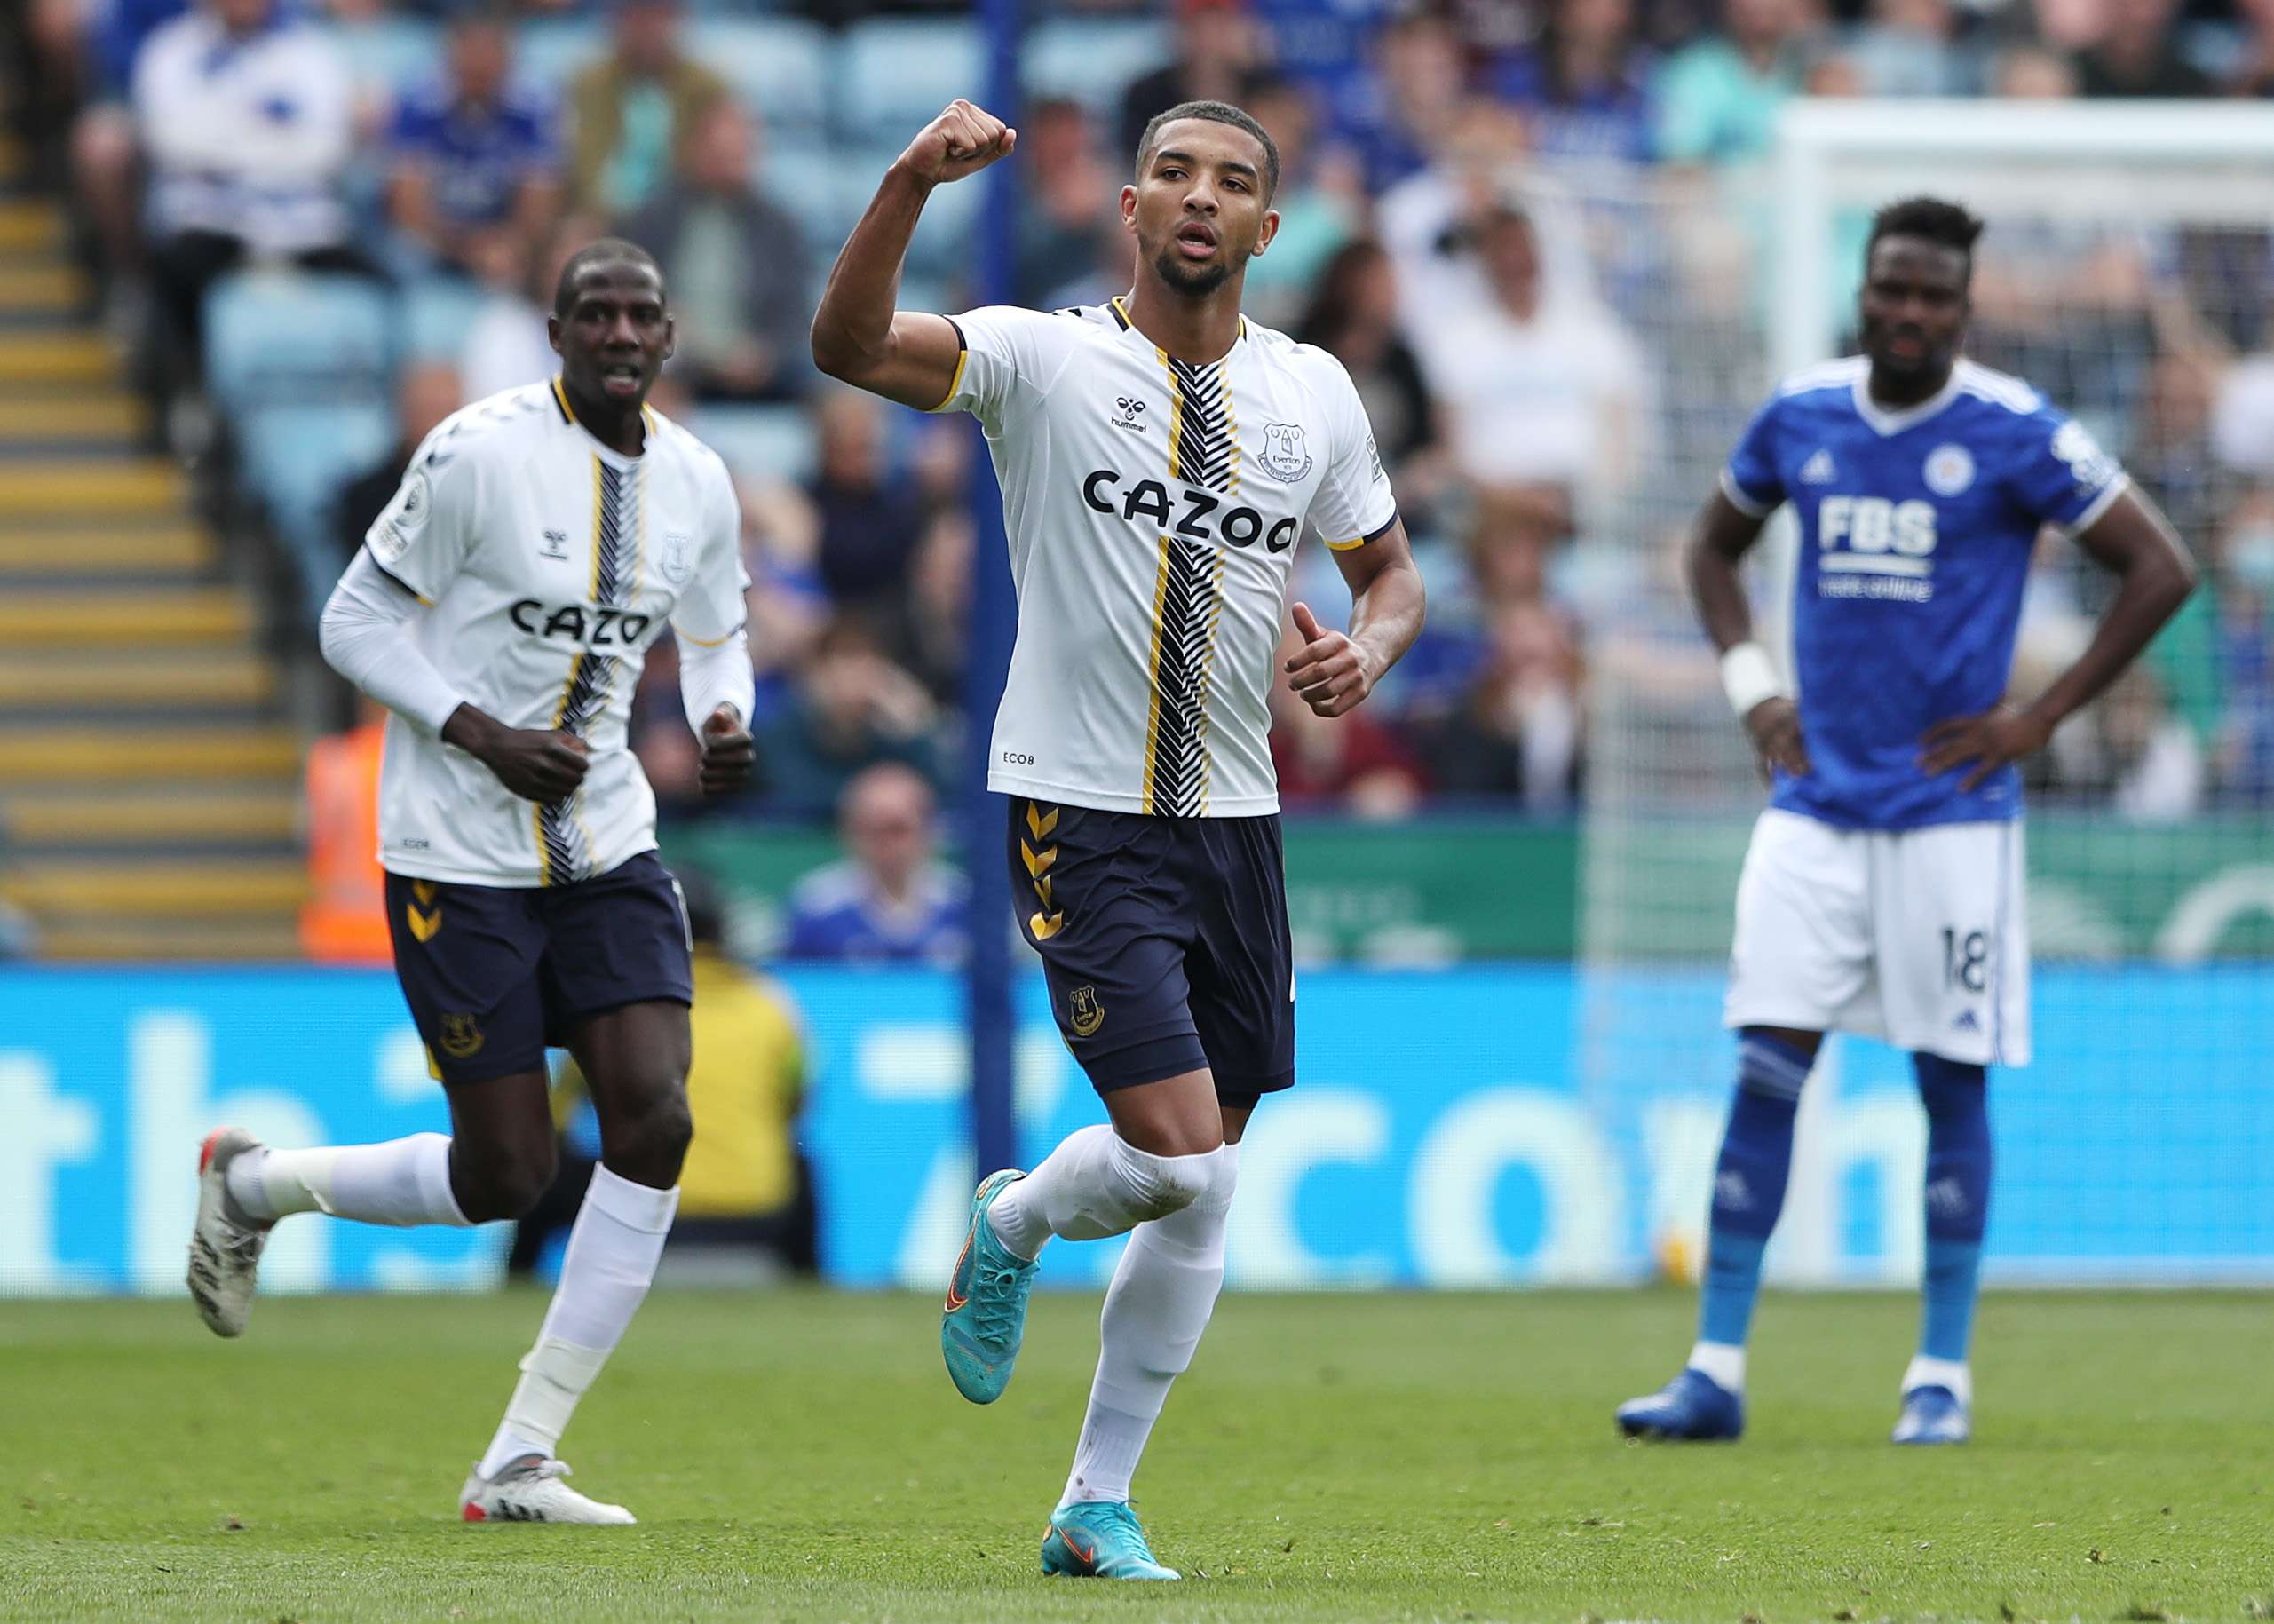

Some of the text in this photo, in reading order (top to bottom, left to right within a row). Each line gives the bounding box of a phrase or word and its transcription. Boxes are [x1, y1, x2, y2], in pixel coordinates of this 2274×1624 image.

[1111, 416, 1147, 433] hummel
[1819, 495, 1938, 556] FBS
[1003, 752, 1034, 765] ECO8
[1939, 928, 1989, 993] 18
